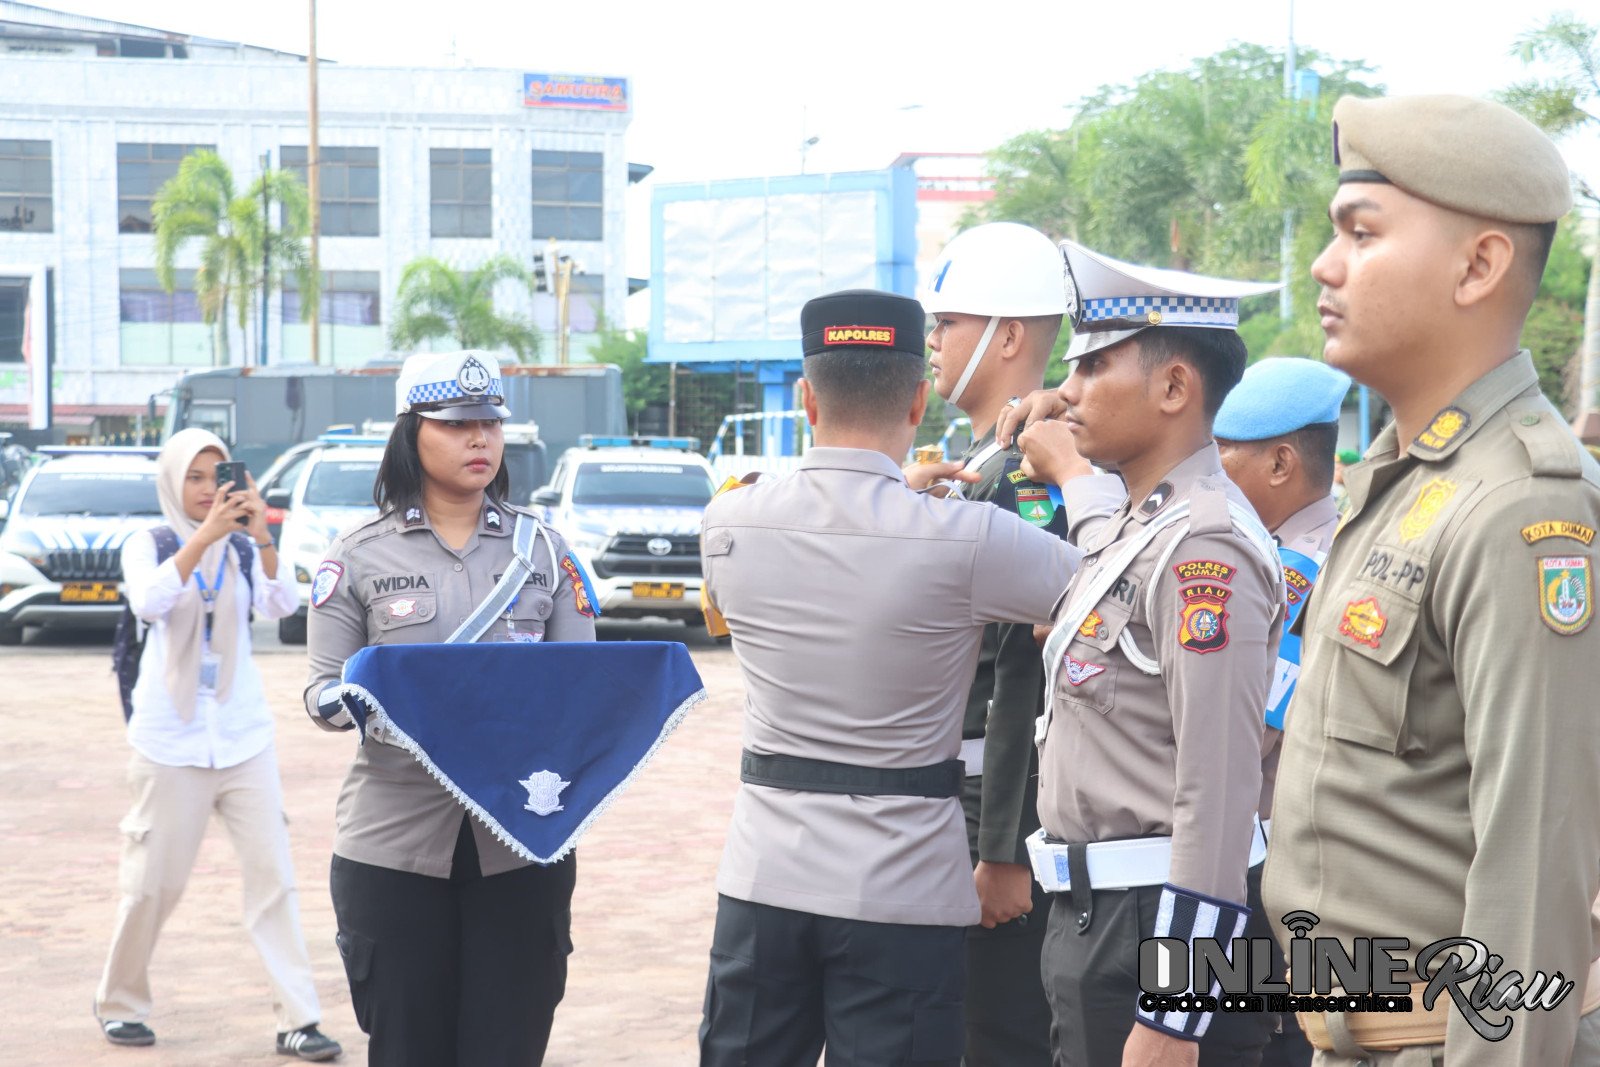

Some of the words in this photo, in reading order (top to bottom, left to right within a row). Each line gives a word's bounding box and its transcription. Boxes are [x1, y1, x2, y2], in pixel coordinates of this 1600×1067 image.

[529, 80, 625, 98] SAMUDRA
[828, 330, 891, 342] KAPOLRES
[1524, 523, 1556, 541] KOTA
[1560, 522, 1592, 542] DUMAI
[1178, 562, 1230, 575] POLRES
[1544, 560, 1562, 569] KOTA
[1184, 570, 1223, 579] DUMAI
[1362, 550, 1426, 595] POL-PP
[373, 575, 430, 594] WIDIA
[1186, 586, 1226, 597] RIAU
